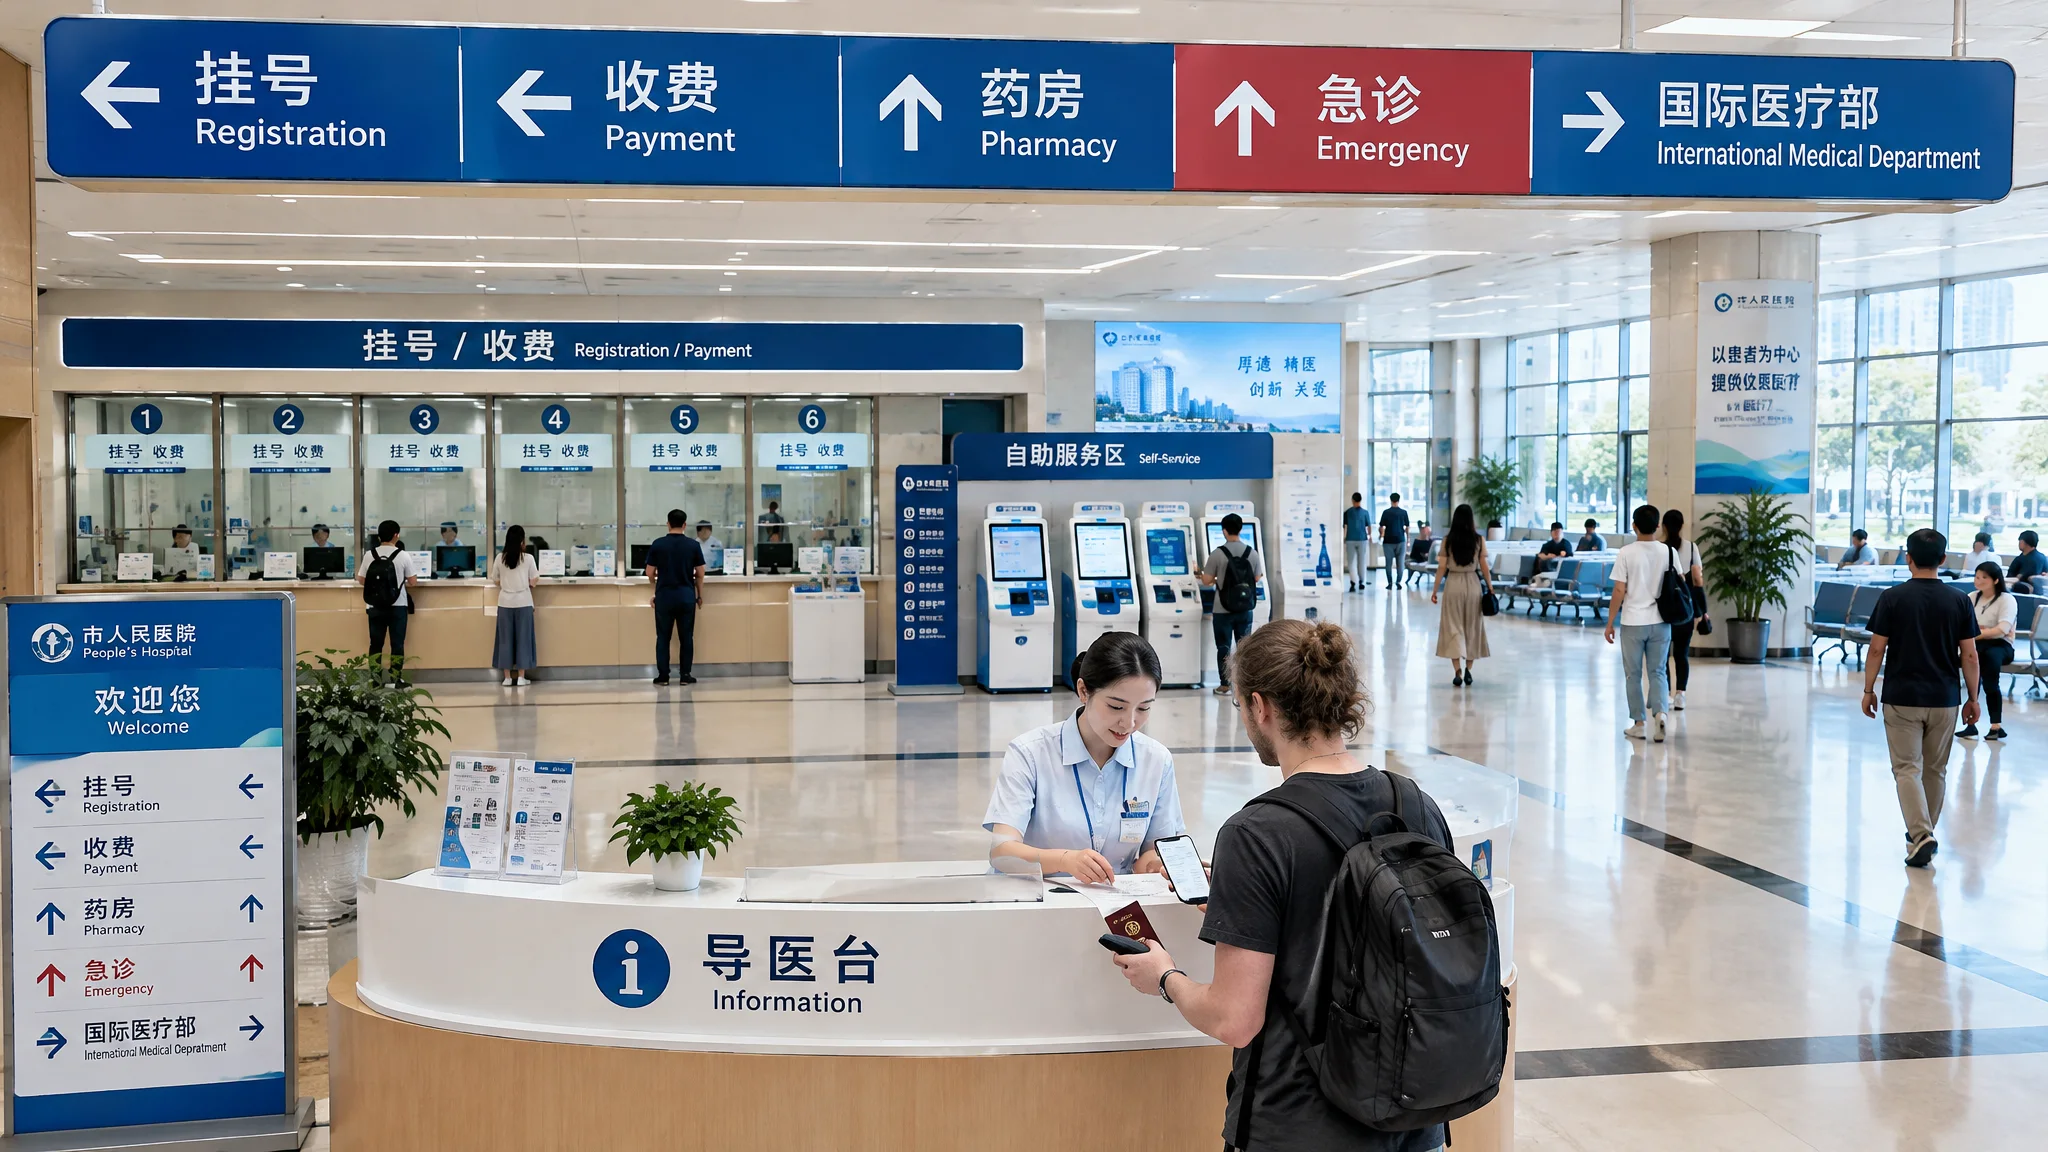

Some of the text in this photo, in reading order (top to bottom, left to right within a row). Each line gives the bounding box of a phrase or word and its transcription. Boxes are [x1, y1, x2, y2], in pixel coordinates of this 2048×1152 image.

[196, 51, 317, 106] 挂号
[606, 60, 717, 113] 收费
[982, 68, 1083, 118] 药房
[1318, 74, 1421, 124] 急诊
[1660, 82, 1878, 129] 国际医疗部
[197, 118, 385, 151] Registration
[607, 125, 735, 156] Payment
[983, 131, 1117, 162] Pharmacy
[1318, 136, 1469, 167] Emergency
[1658, 141, 1980, 173] International Medical Department
[363, 329, 554, 361] 挂号 / 收费
[576, 343, 752, 360] Registration / Payment
[141, 409, 149, 428] 1
[281, 409, 296, 429] 2
[418, 409, 431, 429] 3
[549, 410, 563, 428] 4
[678, 409, 692, 429] 5
[806, 410, 818, 428] 6
[109, 444, 142, 458] 挂号
[253, 444, 284, 458] 挂号
[391, 445, 420, 458] 挂号
[653, 444, 680, 457] 挂号
[781, 444, 807, 457] 挂号
[1007, 442, 1125, 467] 自助服务区
[83, 624, 196, 644] 市人民医院
[84, 646, 191, 660] People's Hospital
[94, 684, 201, 715] 欢迎您
[108, 720, 188, 734] Welcome
[83, 775, 135, 798] 挂号
[83, 799, 160, 814] Registration
[84, 836, 134, 859] 收费
[84, 861, 139, 876] Payment
[84, 897, 134, 920] 药房
[84, 923, 145, 936] Pharmacy
[703, 934, 879, 983] 导医台
[85, 958, 135, 981] 急诊
[84, 983, 154, 998] Emergency
[715, 990, 861, 1013] Information
[84, 1015, 196, 1044] 国际医疗部
[140, 1044, 171, 1056] Medical
